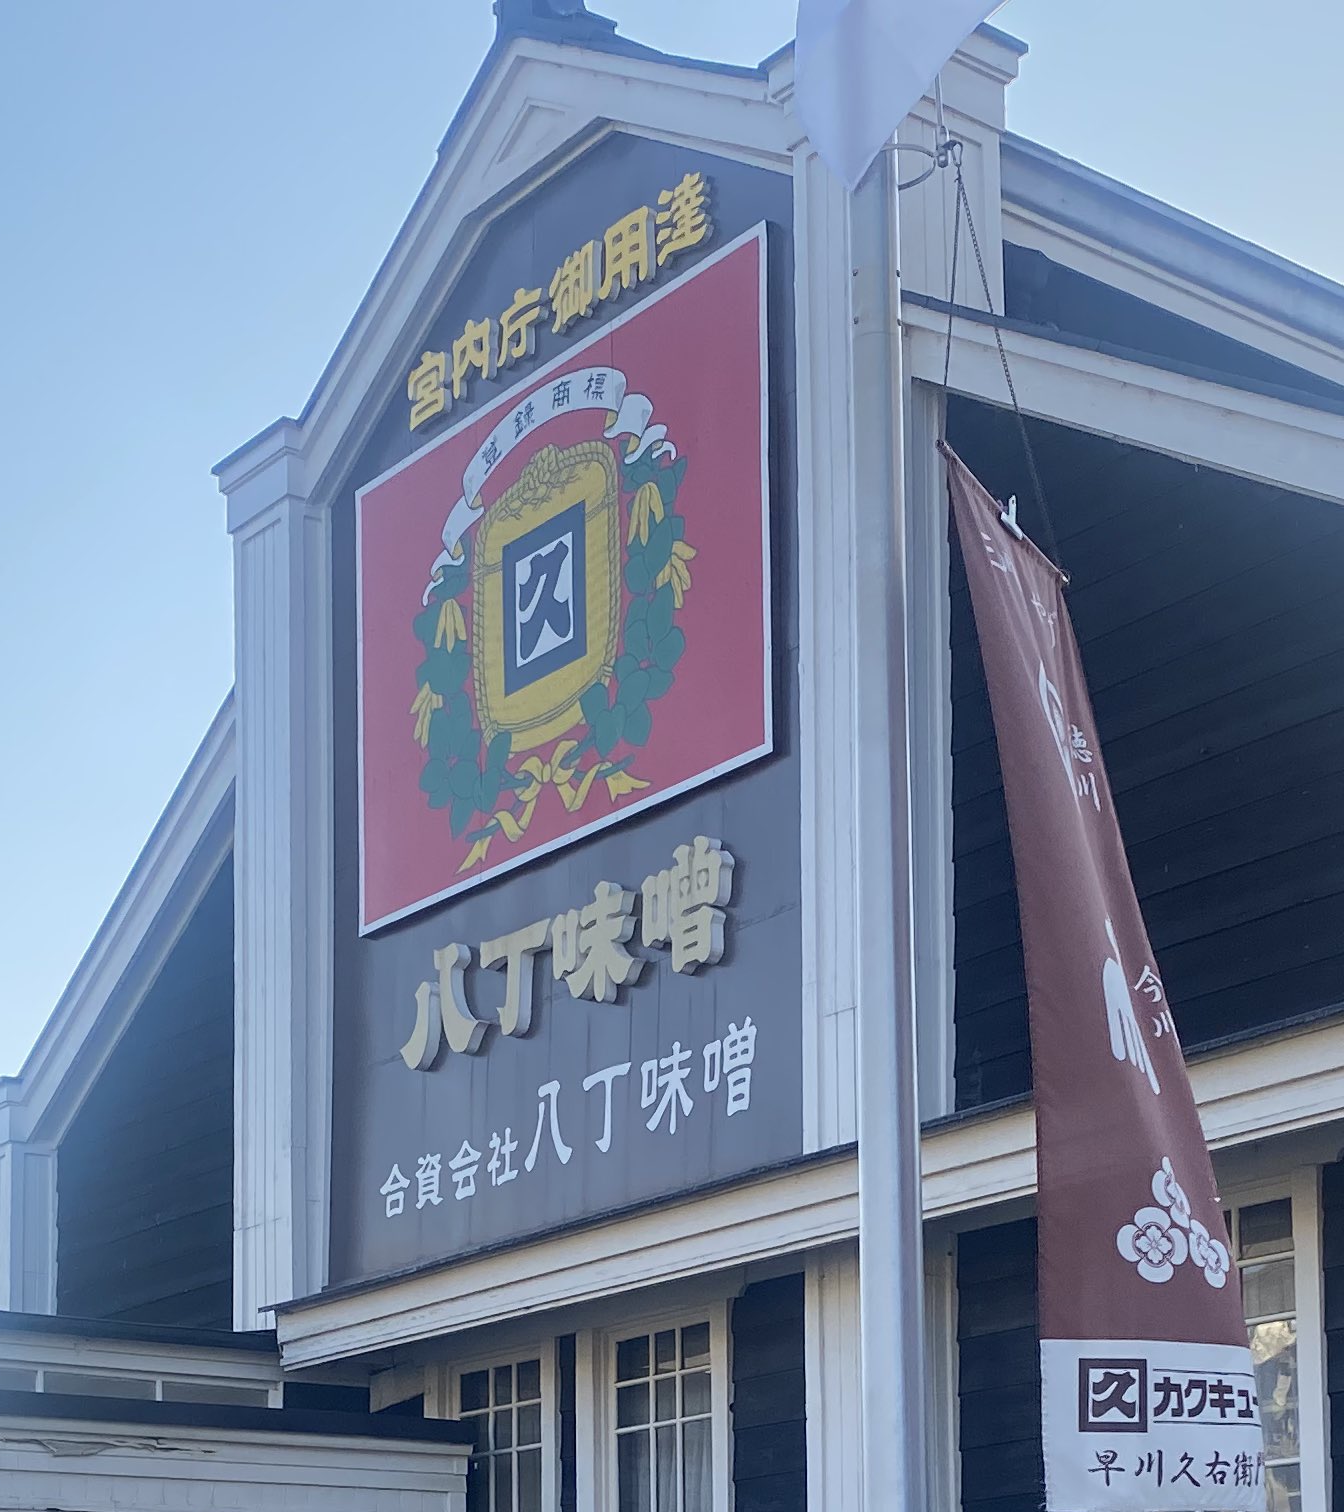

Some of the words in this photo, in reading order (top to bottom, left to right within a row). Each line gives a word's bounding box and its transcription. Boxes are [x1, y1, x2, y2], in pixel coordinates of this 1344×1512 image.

[516, 533, 573, 667] 久
[400, 834, 738, 1072] 八丁味噌
[1133, 964, 1180, 1047] 今川
[379, 1015, 759, 1220] 合資会社八丁味噌
